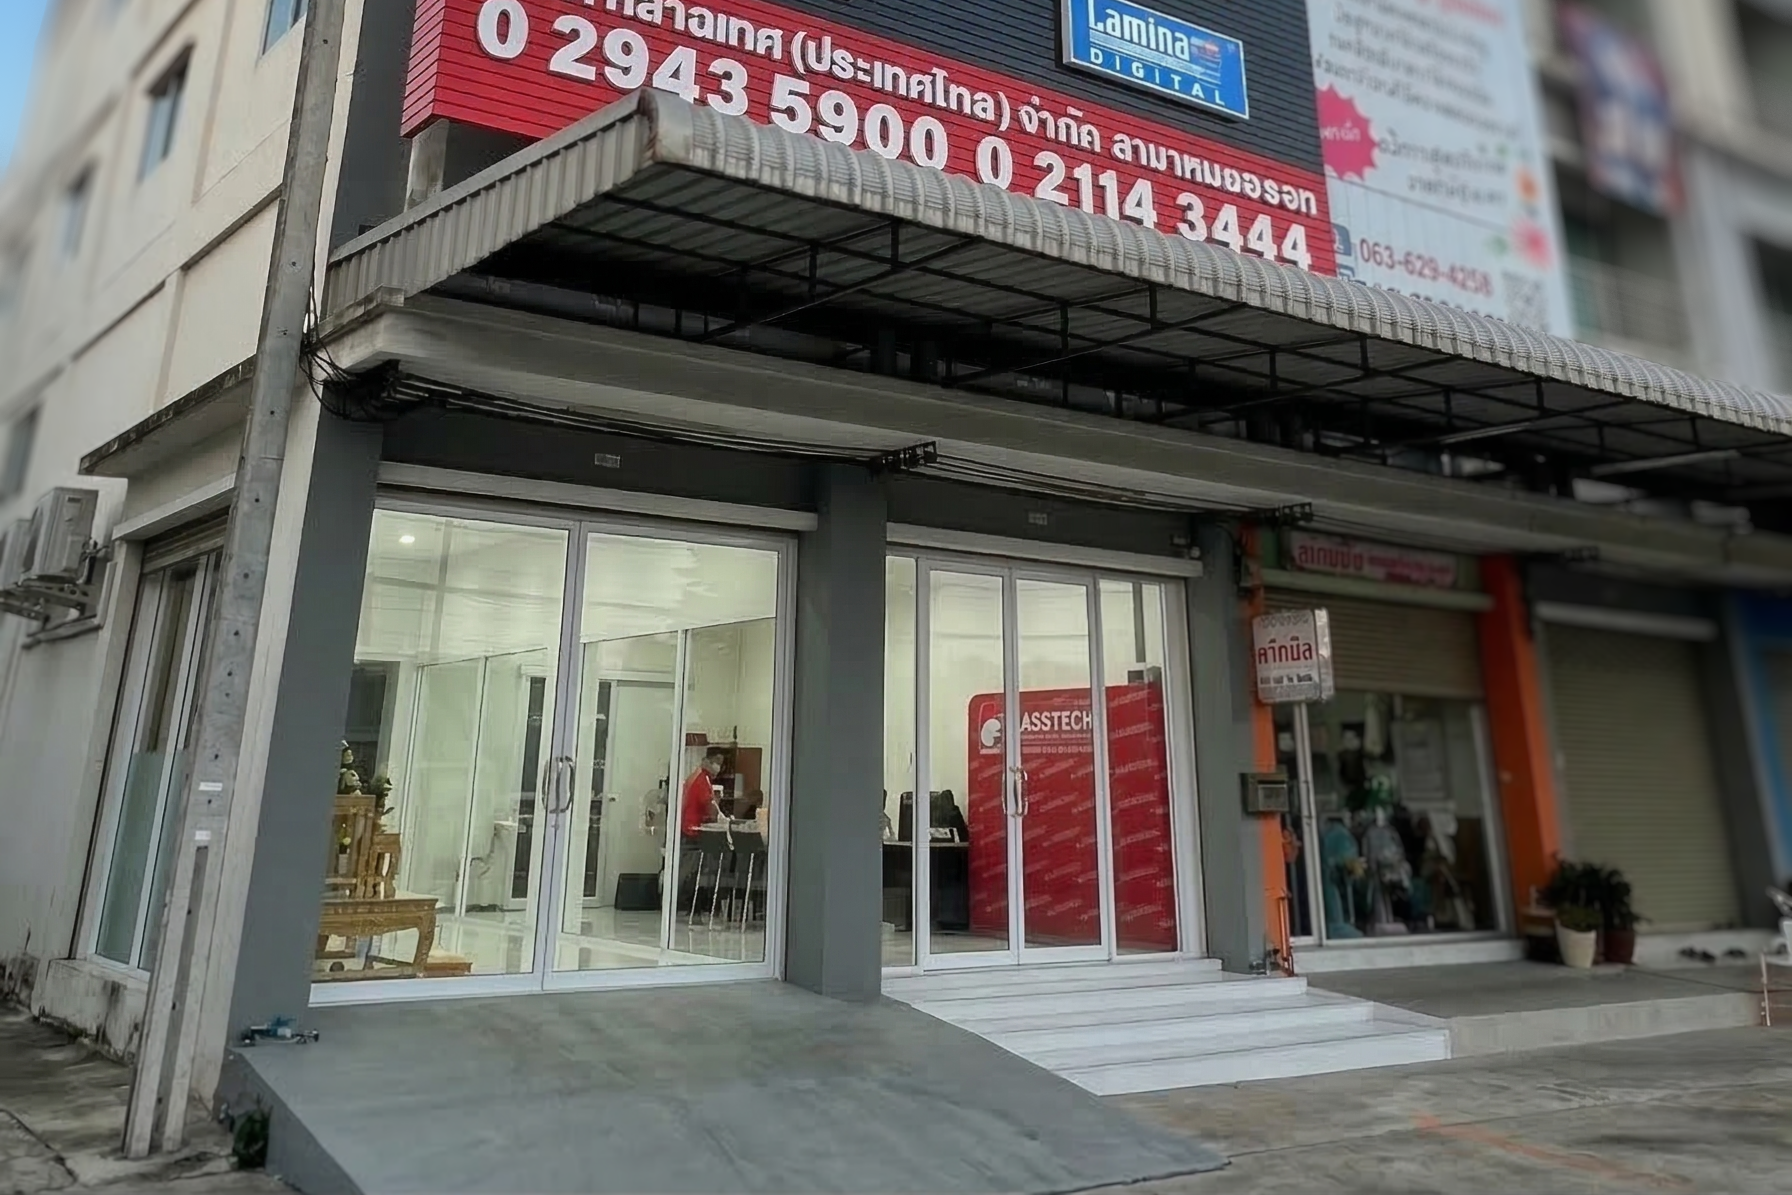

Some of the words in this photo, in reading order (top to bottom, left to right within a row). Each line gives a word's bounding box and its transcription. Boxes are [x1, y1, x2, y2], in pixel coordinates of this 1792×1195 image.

[1090, 47, 1226, 106] DIGITAL
[548, 14, 749, 116] 2943
[769, 73, 949, 171] 5900
[975, 136, 1013, 191] 0
[1033, 150, 1158, 229] 2114
[1175, 192, 1312, 271] 3444
[1019, 709, 1093, 732] ASSTECH
